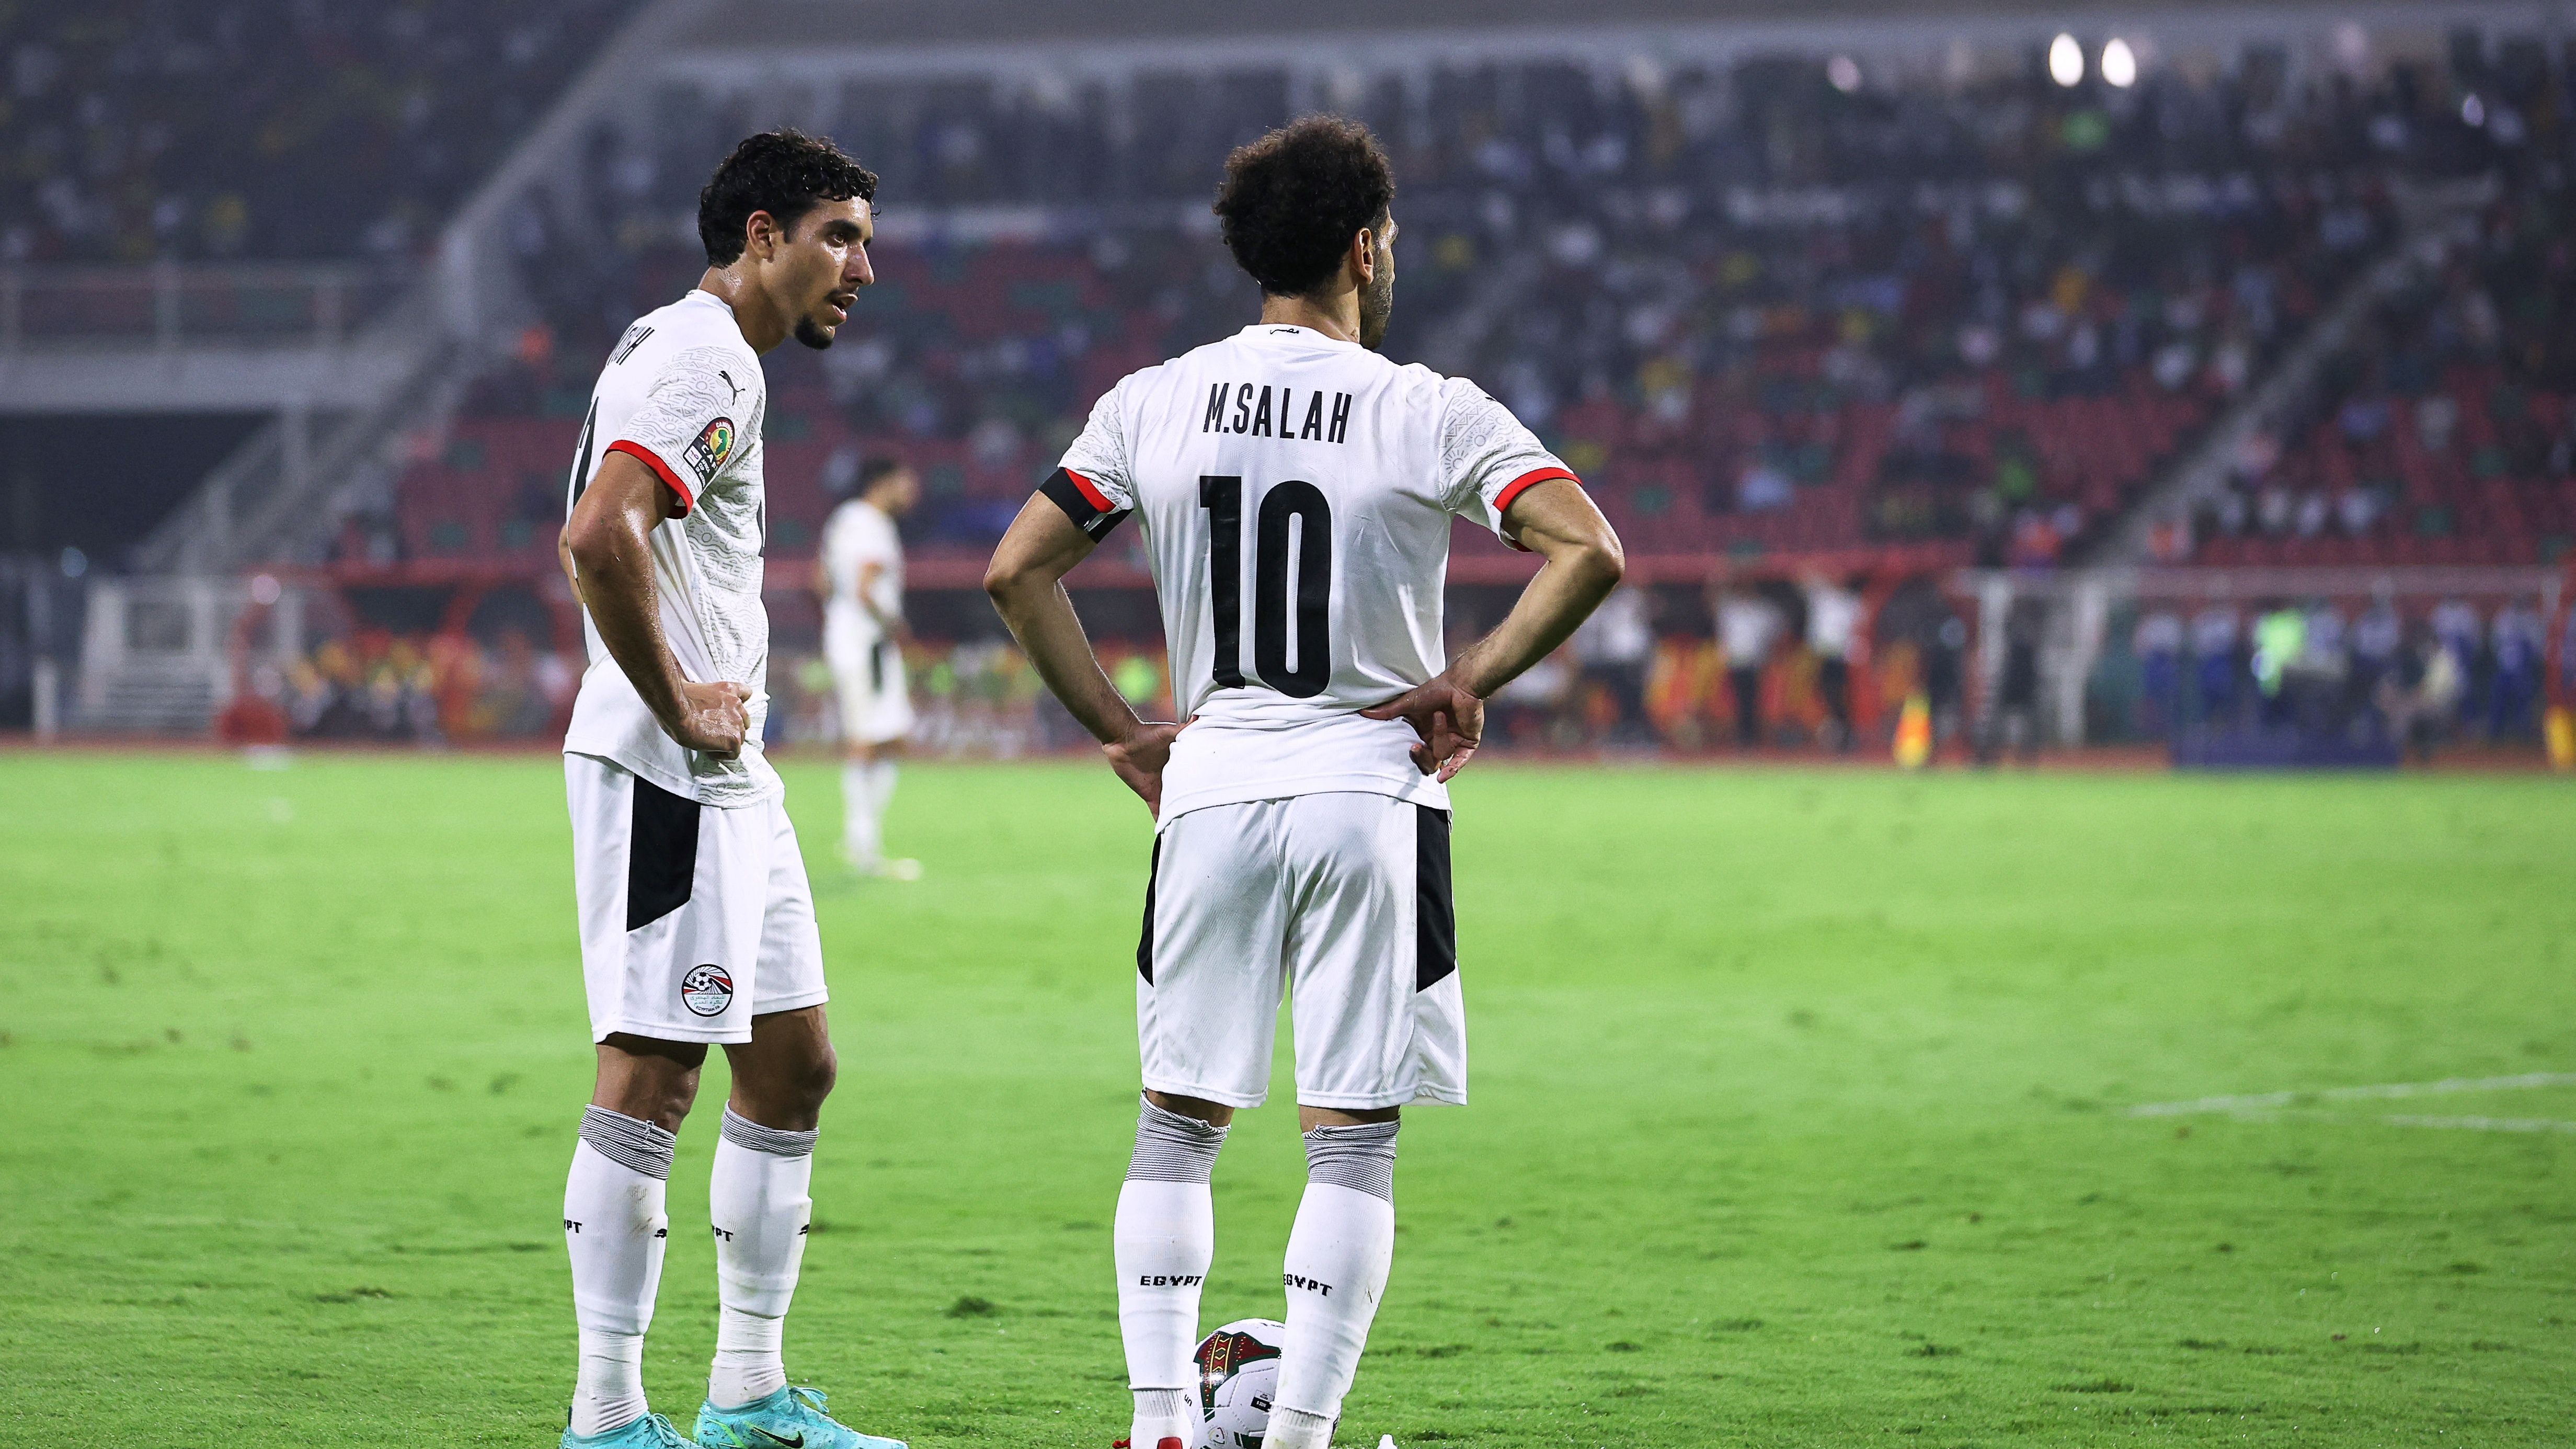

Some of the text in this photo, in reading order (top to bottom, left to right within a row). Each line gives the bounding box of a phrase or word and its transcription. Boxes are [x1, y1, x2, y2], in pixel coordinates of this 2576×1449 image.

[1203, 382, 1352, 444] M.SALAH
[1199, 475, 1332, 699] 10
[1140, 1275, 1202, 1286] EGYPT
[1283, 1273, 1333, 1297] EGYPT
